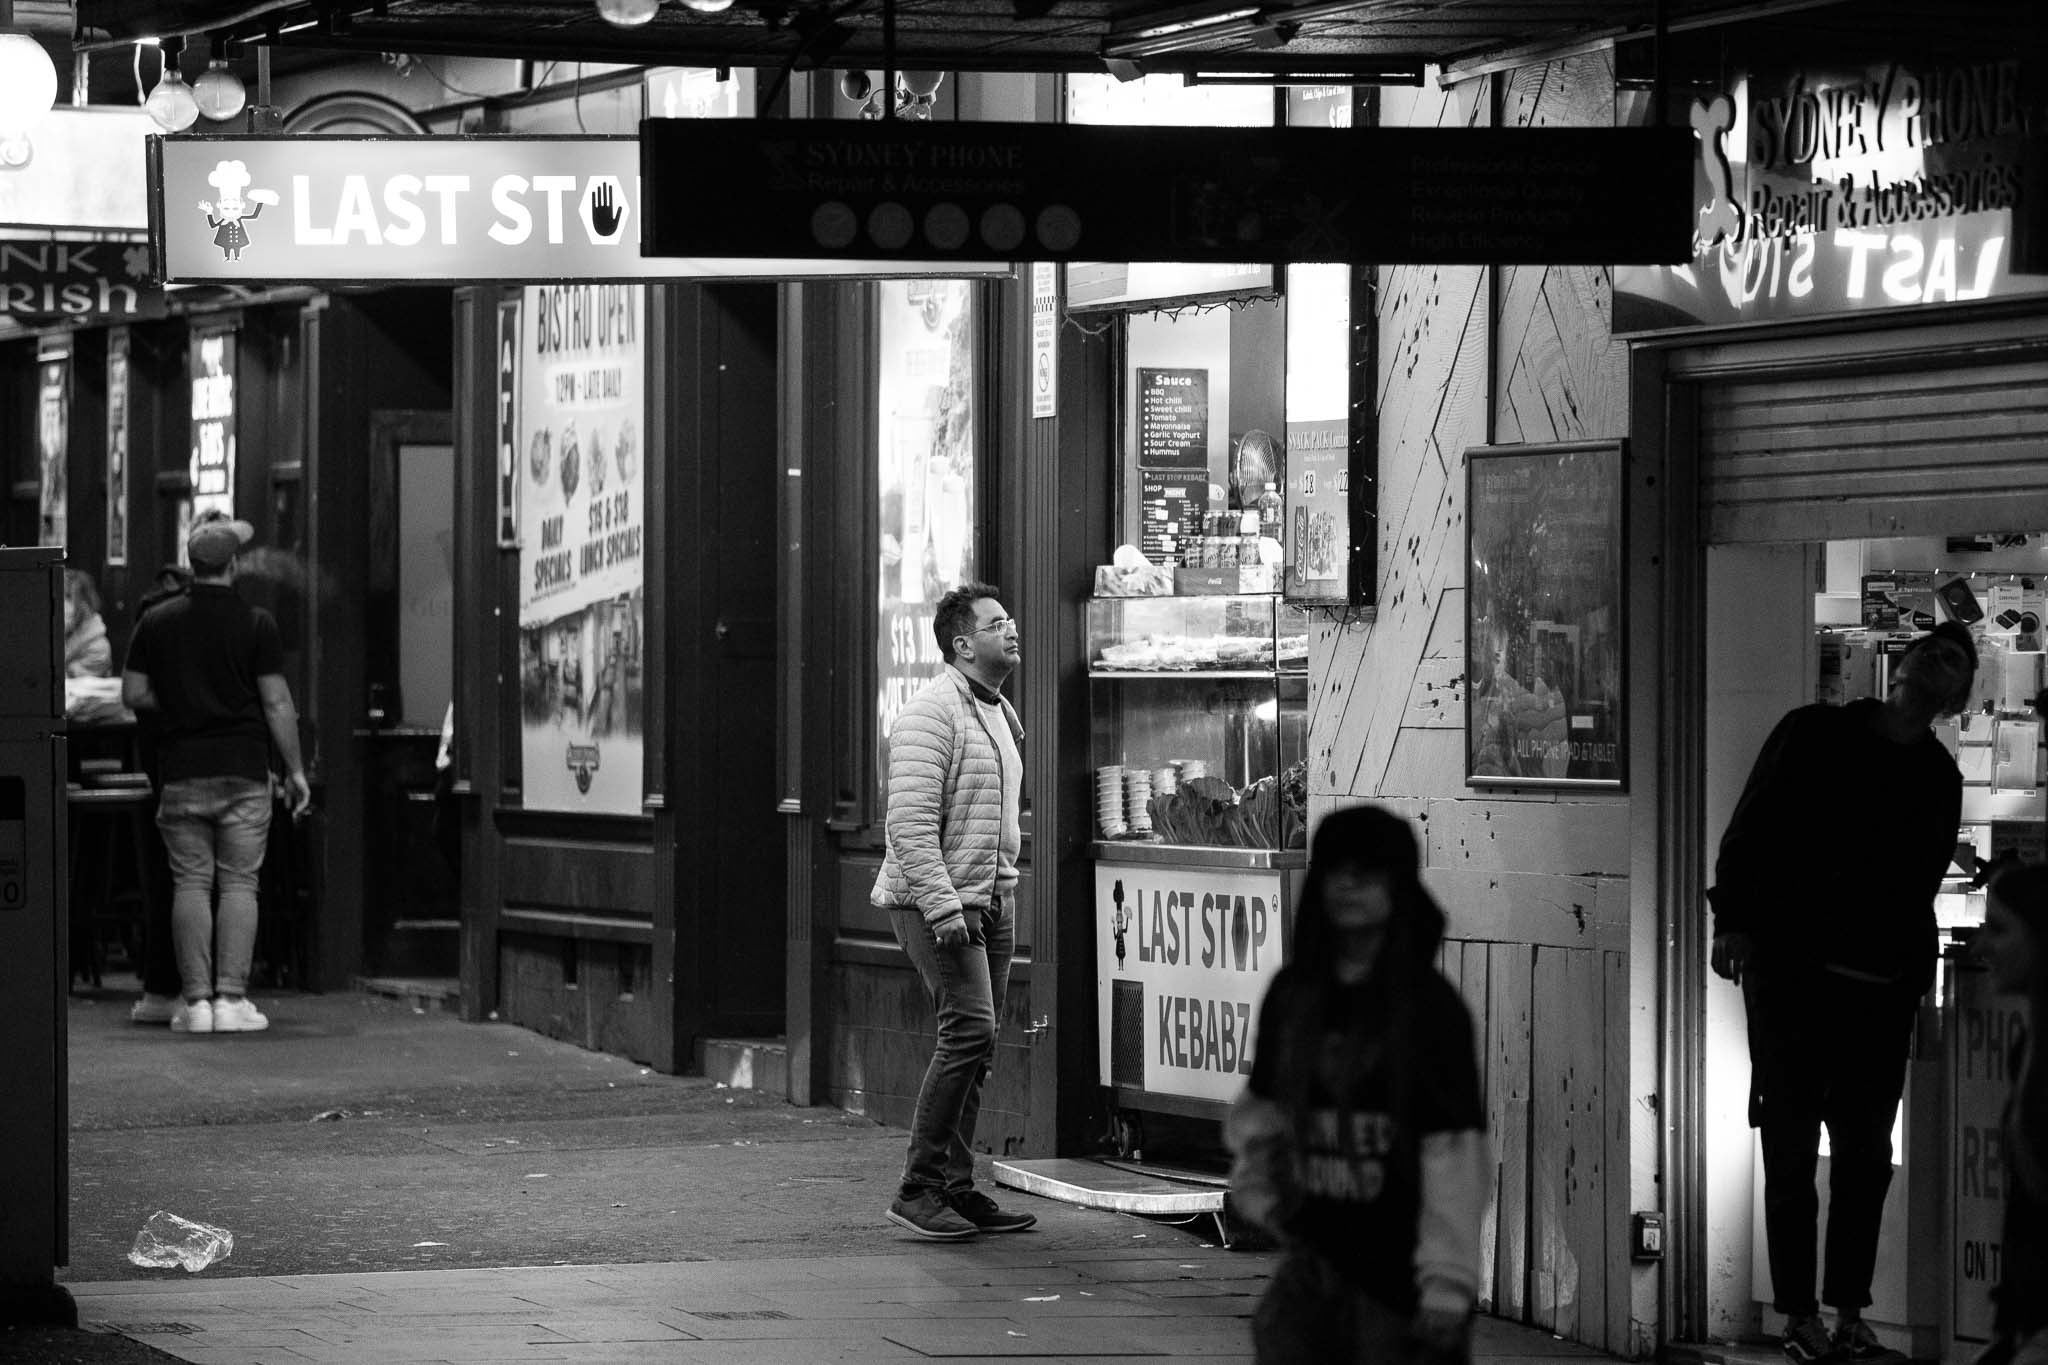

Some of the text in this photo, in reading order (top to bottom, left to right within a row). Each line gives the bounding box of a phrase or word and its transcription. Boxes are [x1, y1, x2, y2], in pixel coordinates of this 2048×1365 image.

[293, 174, 641, 246] LAST STO
[537, 285, 636, 354] BISTRO OPEN
[1155, 375, 1192, 386] Sauce
[1150, 405, 1173, 413] Sweet
[1150, 423, 1191, 432] Mayonnaise
[1150, 431, 1201, 440] Garlic Yoghurt
[891, 613, 917, 666] $13
[1138, 888, 1267, 972] LAST STOP
[1159, 995, 1252, 1077] KEBABZ
